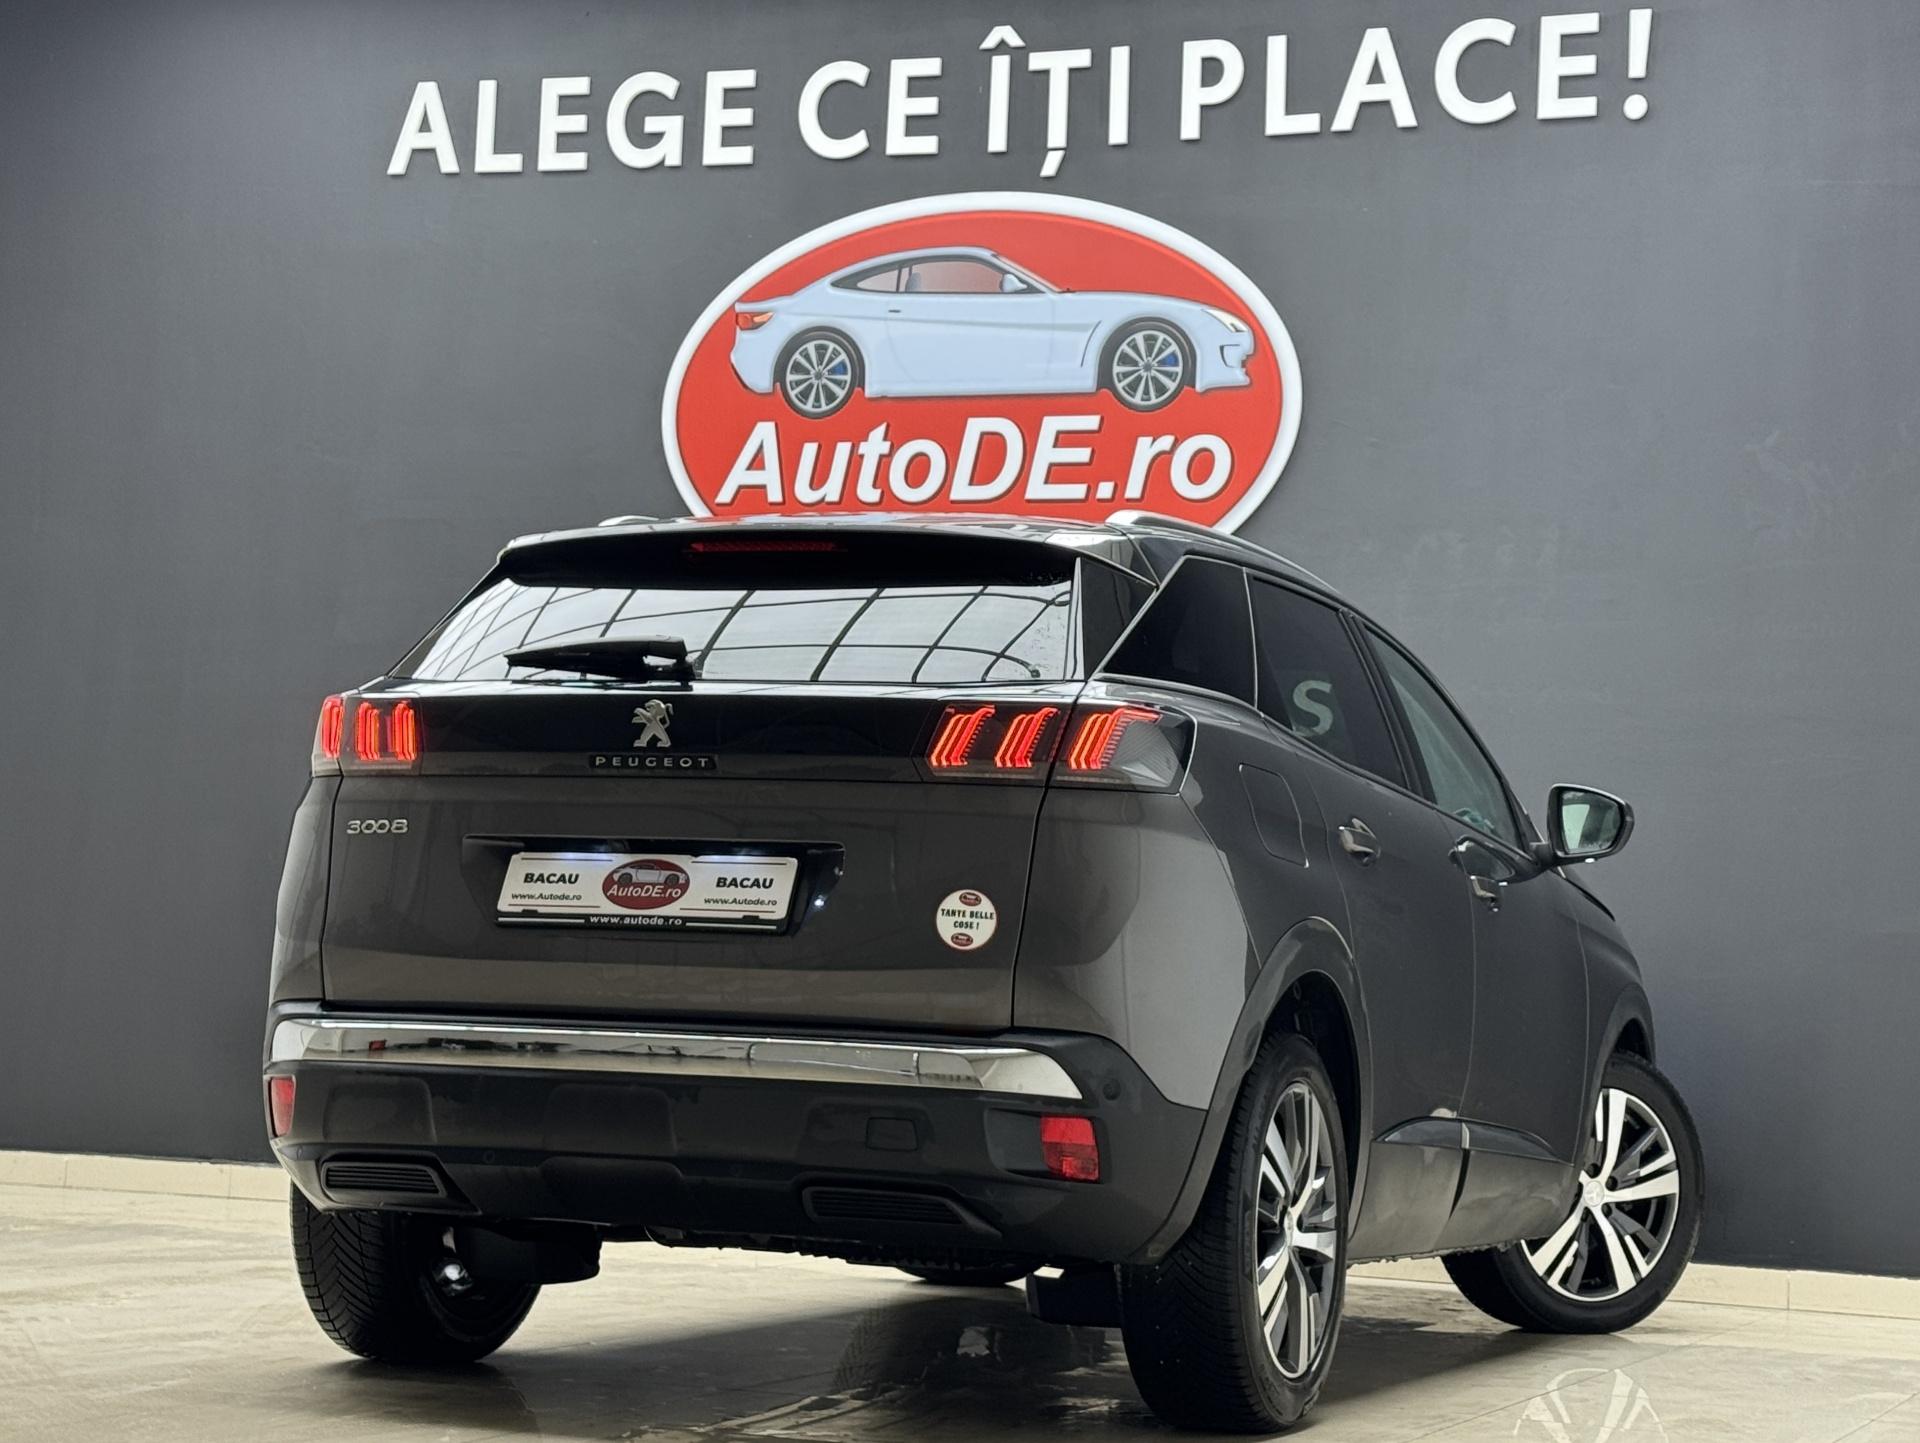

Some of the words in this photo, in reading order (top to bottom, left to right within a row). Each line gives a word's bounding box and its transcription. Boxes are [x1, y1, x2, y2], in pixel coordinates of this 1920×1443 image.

[387, 69, 756, 176] ALEGE
[797, 57, 943, 160] CE
[1179, 8, 1653, 141] PLACE!
[715, 414, 1234, 507] AutoDE.ro
[595, 755, 710, 769] PEUGEOT
[347, 819, 408, 834] 3008
[523, 872, 580, 885] BACAU
[715, 876, 775, 890] BACAU
[511, 892, 583, 902] www.Autode.ro
[606, 884, 681, 899] AutoDE.ro
[703, 896, 778, 907] www.Autode.ro
[941, 908, 966, 918] TANTE
[969, 911, 994, 920] BELLE
[589, 915, 683, 927] www.autode.ro
[953, 921, 974, 929] COSE
